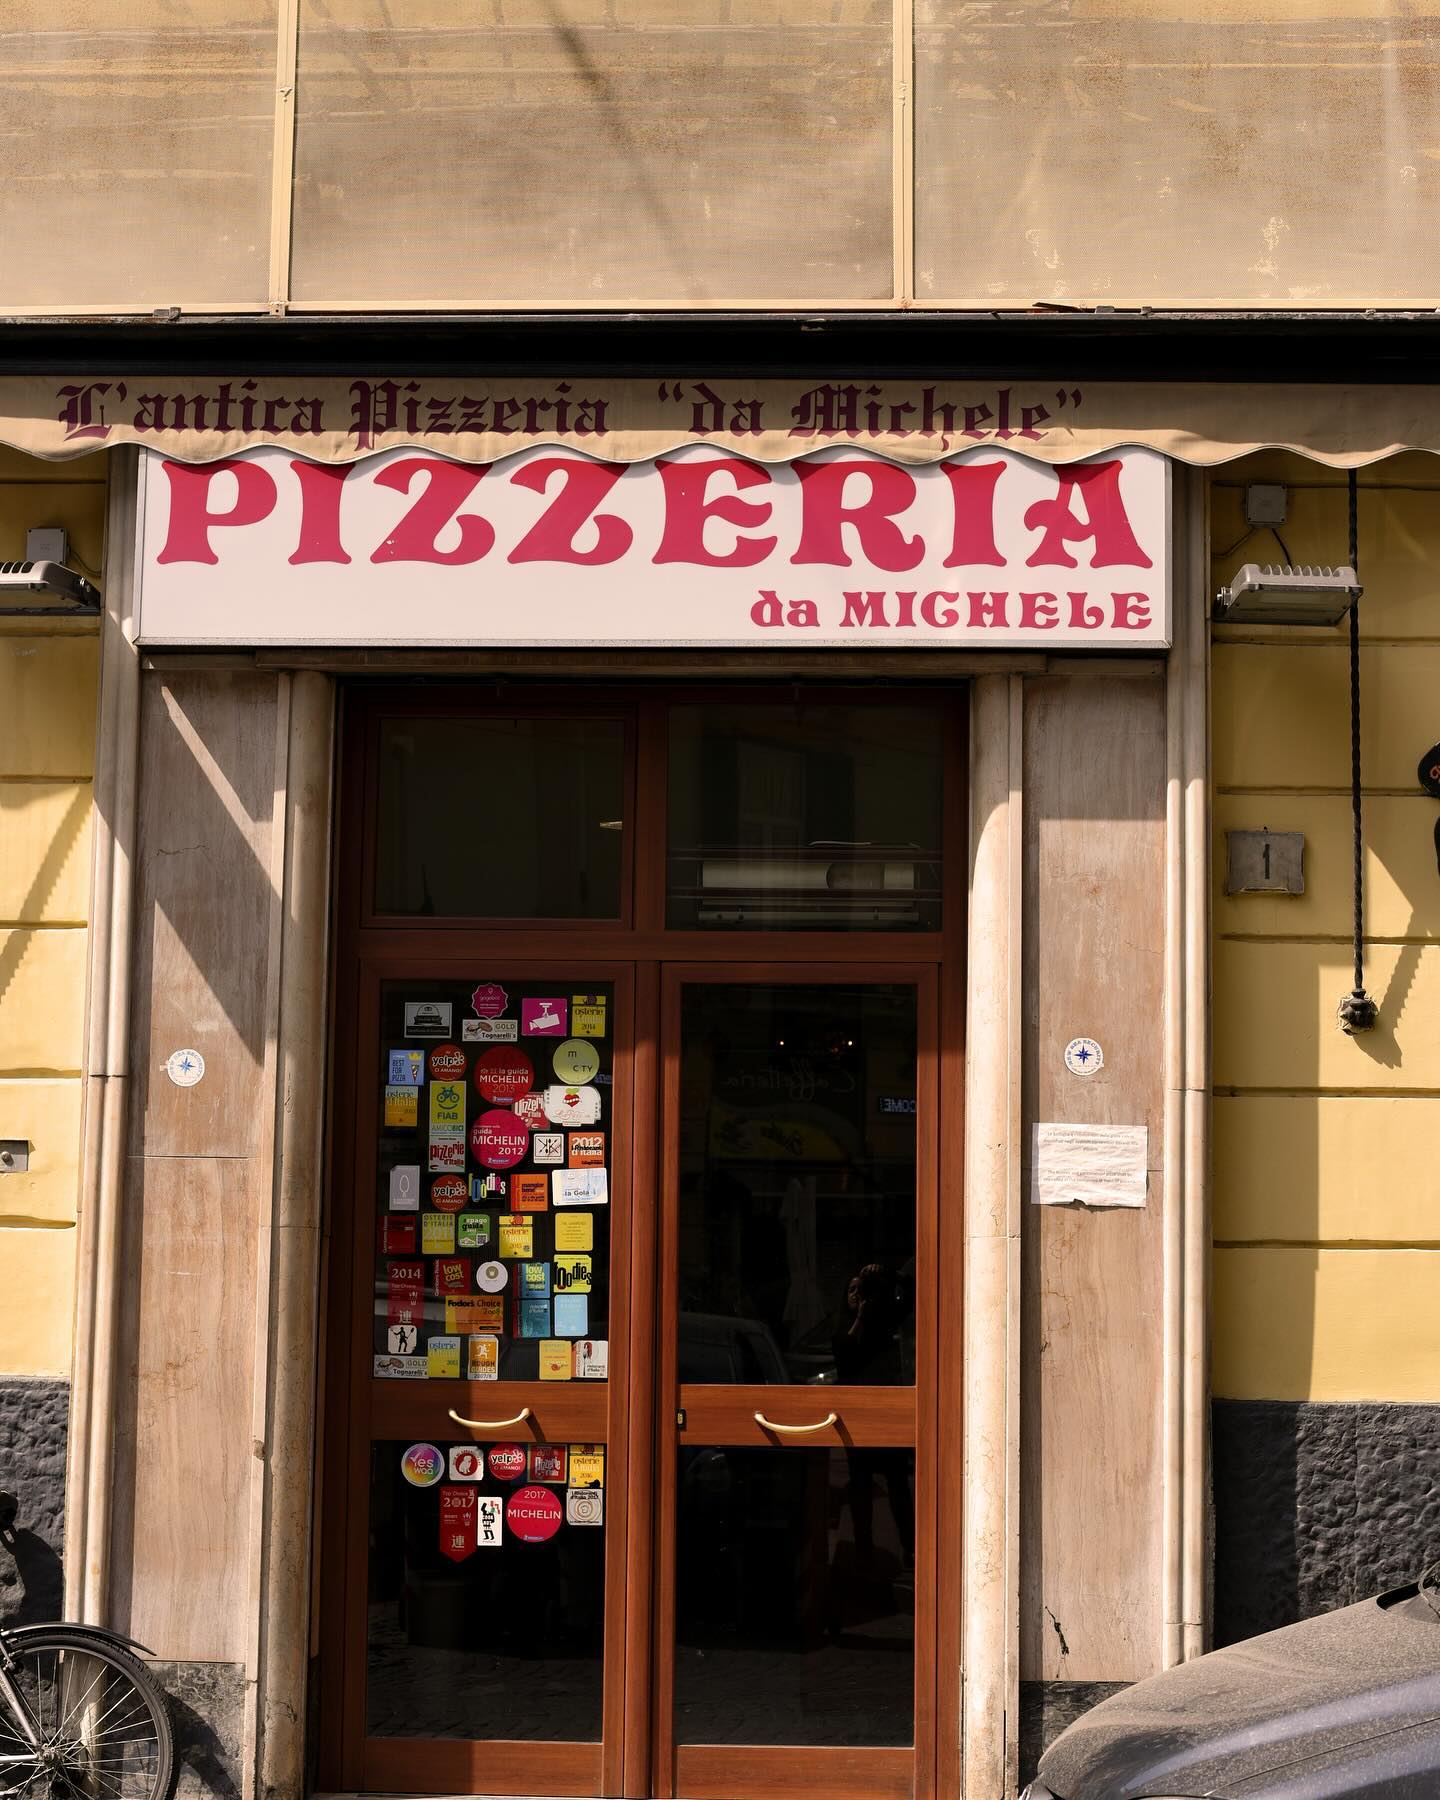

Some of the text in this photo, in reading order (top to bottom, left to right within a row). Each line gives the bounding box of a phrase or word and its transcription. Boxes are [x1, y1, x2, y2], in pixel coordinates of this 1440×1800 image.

[349, 379, 610, 452] Pizzeria
[156, 457, 1153, 572] PIZZERIA
[750, 591, 1153, 630] da MICHELE
[1262, 843, 1271, 880] 1
[507, 1067, 529, 1076] guida
[479, 1075, 529, 1084] MICHELIN
[437, 1112, 459, 1120] FIAB
[472, 1128, 493, 1136] guida
[472, 1136, 526, 1146] MICHELIN
[571, 1136, 603, 1148] 2012
[429, 1141, 465, 1161] pizzerie
[498, 1147, 524, 1156] 2012
[433, 1184, 456, 1198] yelp
[391, 1267, 422, 1279] 2014
[443, 1264, 462, 1274] low
[445, 1271, 465, 1282] cost
[407, 1359, 427, 1367] GOLD
[491, 1453, 514, 1465] yelp
[524, 1490, 546, 1499] 2017
[507, 1508, 562, 1520] MICHELIN
